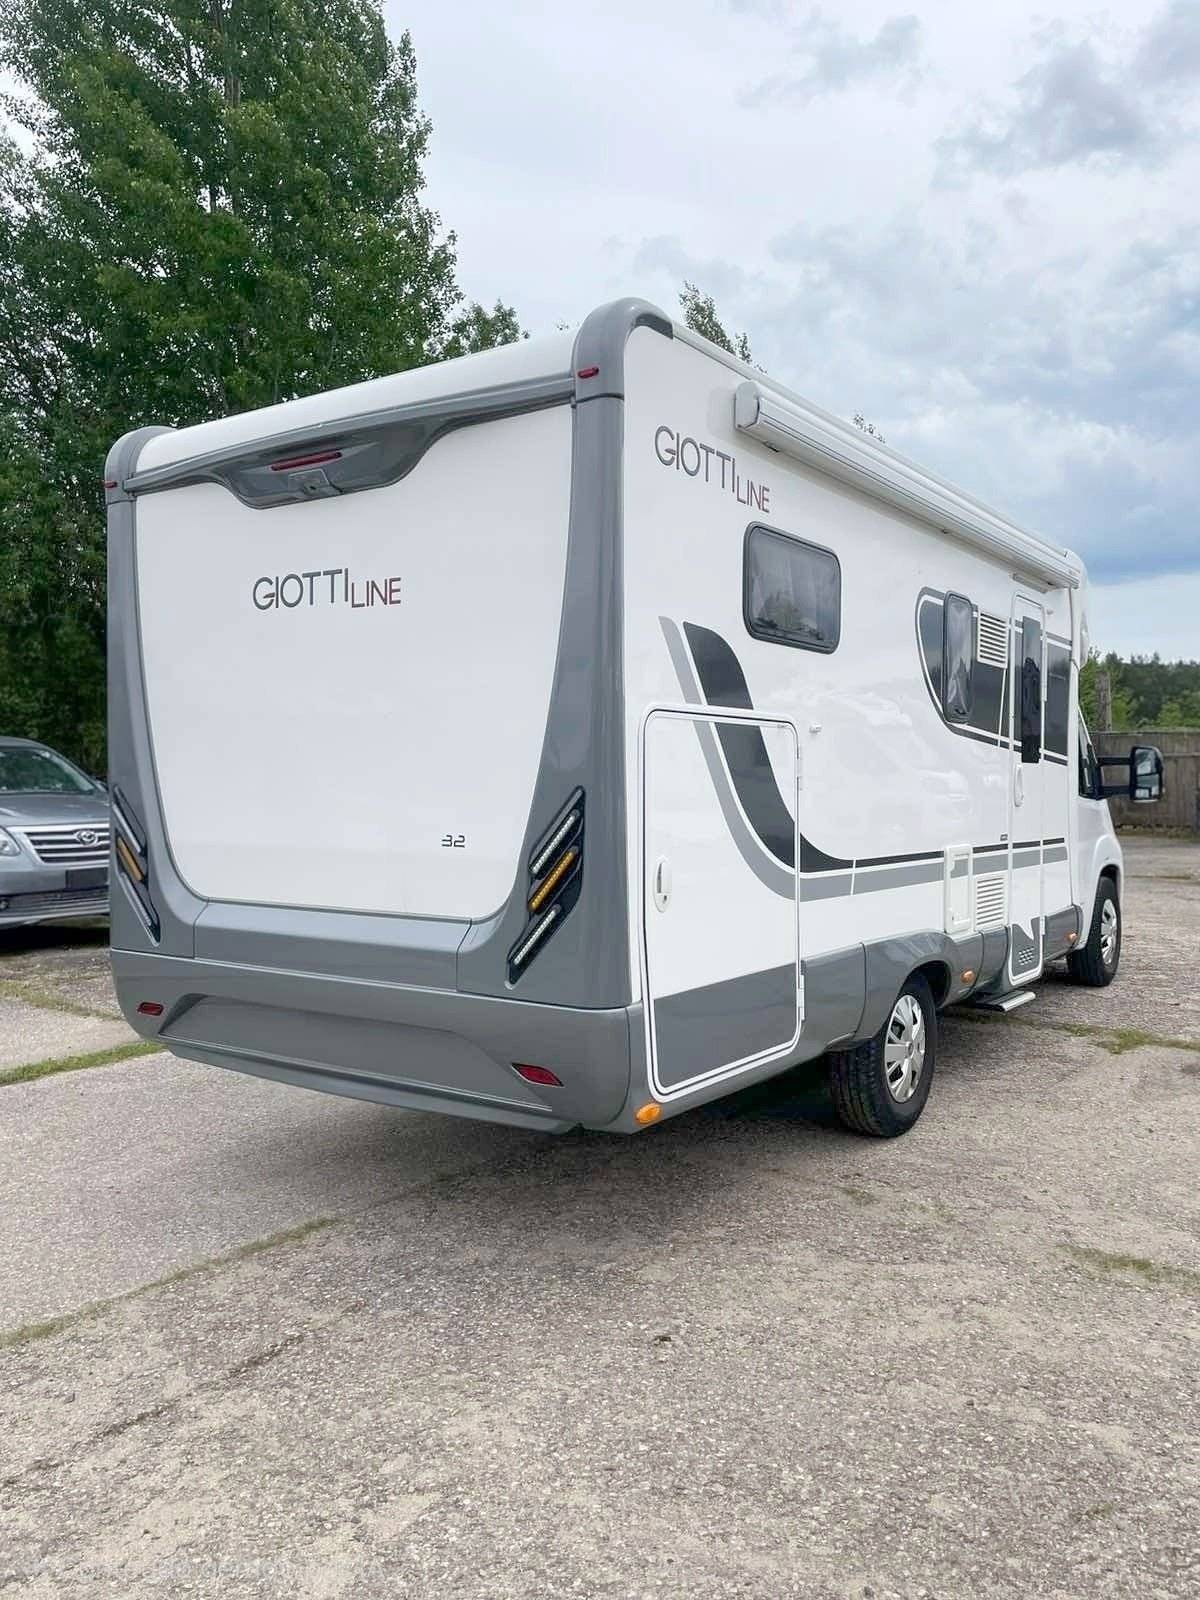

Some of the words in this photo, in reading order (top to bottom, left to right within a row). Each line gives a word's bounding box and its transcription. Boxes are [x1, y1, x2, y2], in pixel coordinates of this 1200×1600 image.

[654, 425, 770, 514] GIOTTILINE
[252, 567, 401, 610] GIOTTILINE
[441, 834, 466, 848] 32
